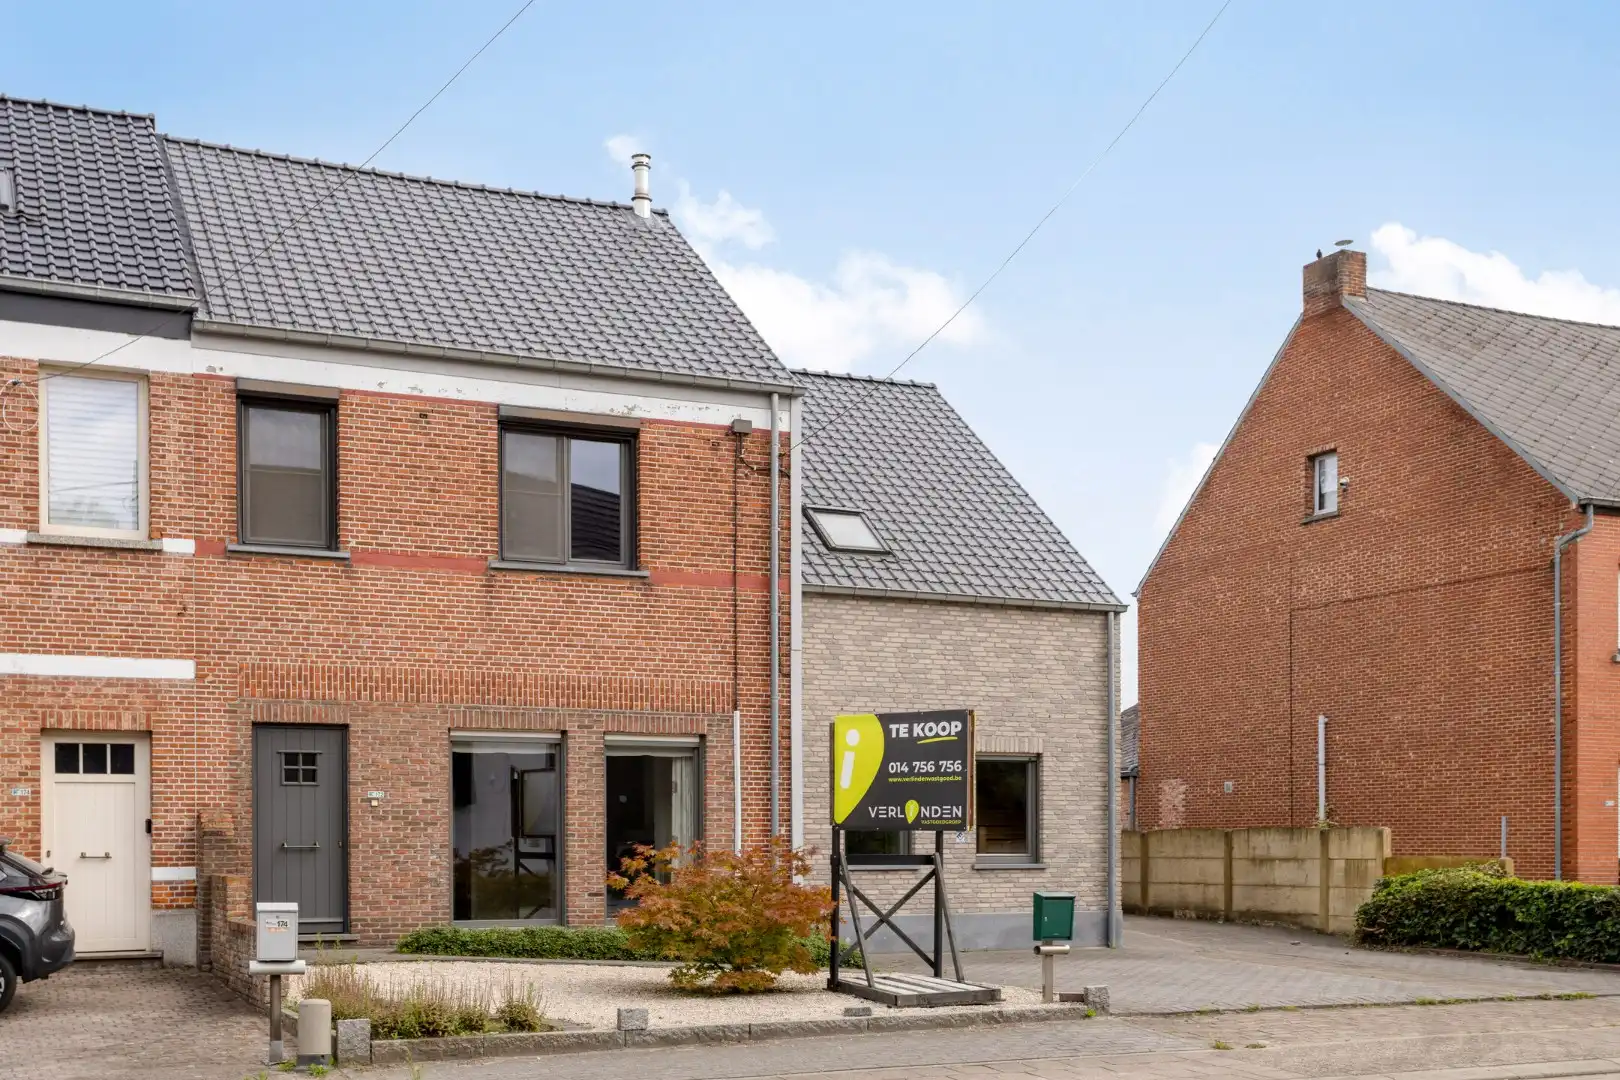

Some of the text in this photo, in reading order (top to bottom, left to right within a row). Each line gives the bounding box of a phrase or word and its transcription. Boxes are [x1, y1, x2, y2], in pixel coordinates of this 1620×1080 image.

[889, 721, 962, 738] TE KOOP
[888, 760, 962, 773] 014 756 756
[277, 920, 288, 928] 174
